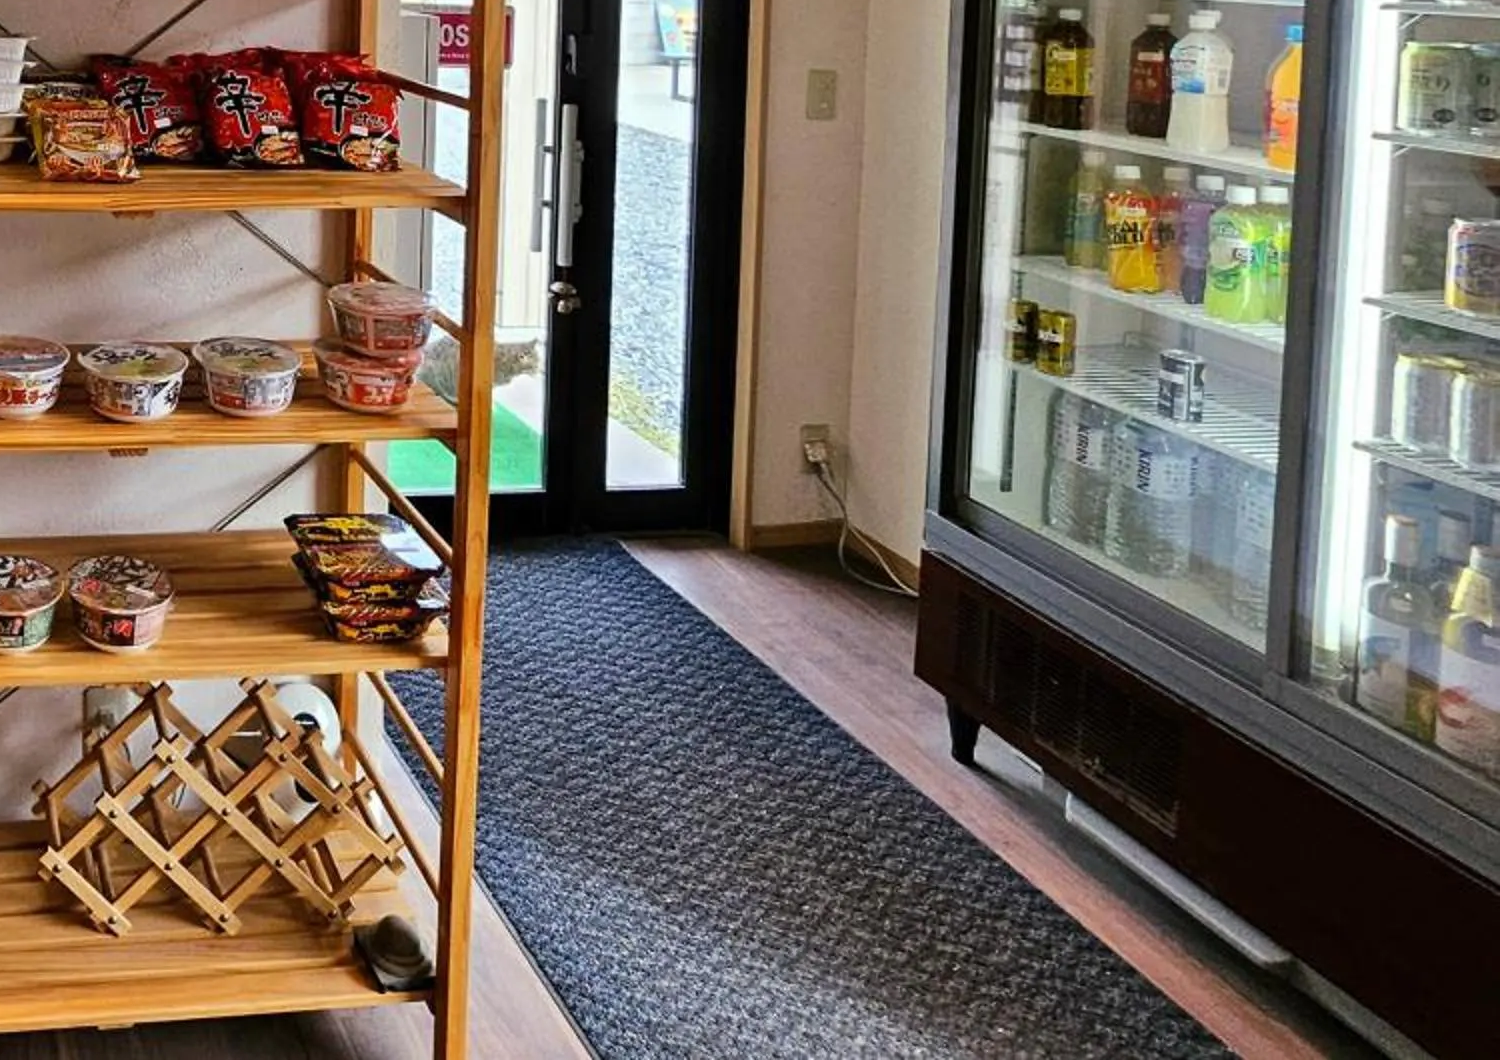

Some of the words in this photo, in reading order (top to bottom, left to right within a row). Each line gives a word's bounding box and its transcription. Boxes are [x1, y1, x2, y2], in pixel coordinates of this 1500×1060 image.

[440, 23, 470, 47] OS
[113, 74, 167, 135] 辛
[213, 70, 267, 138] 辛
[1137, 448, 1154, 493] KIRIN
